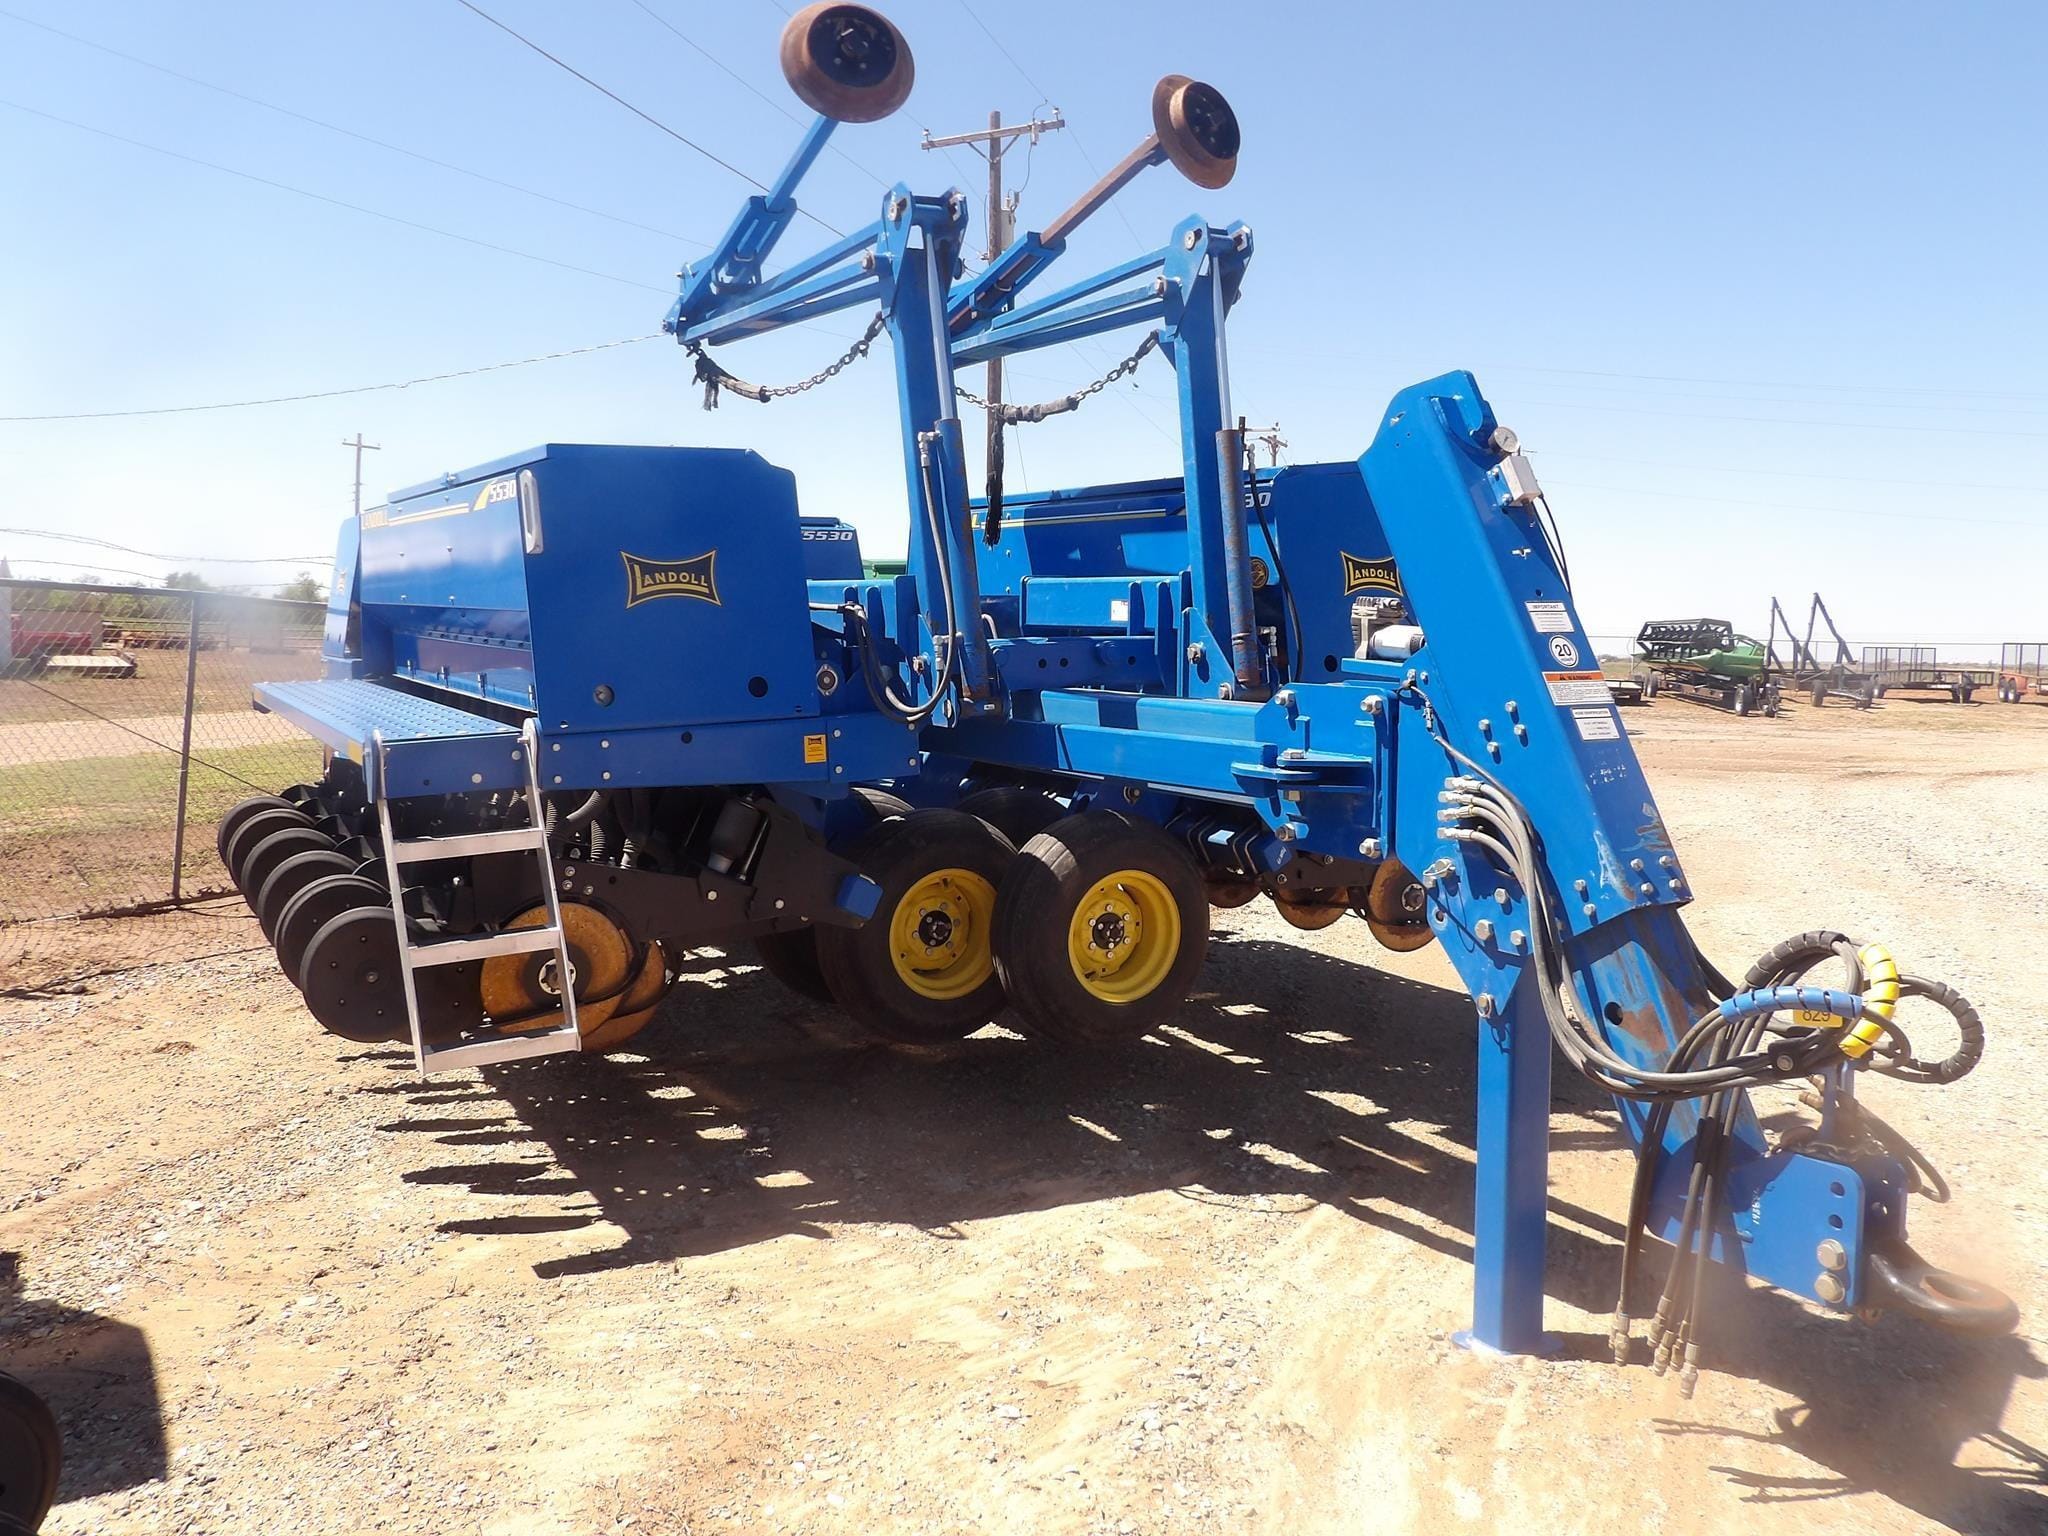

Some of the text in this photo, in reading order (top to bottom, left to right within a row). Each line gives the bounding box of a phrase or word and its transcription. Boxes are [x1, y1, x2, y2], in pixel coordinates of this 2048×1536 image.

[489, 480, 516, 502] 5530
[802, 531, 853, 541] 5530
[633, 564, 709, 596] LANDOLL
[1348, 561, 1397, 587] LANDOLL
[1555, 644, 1572, 656] 20
